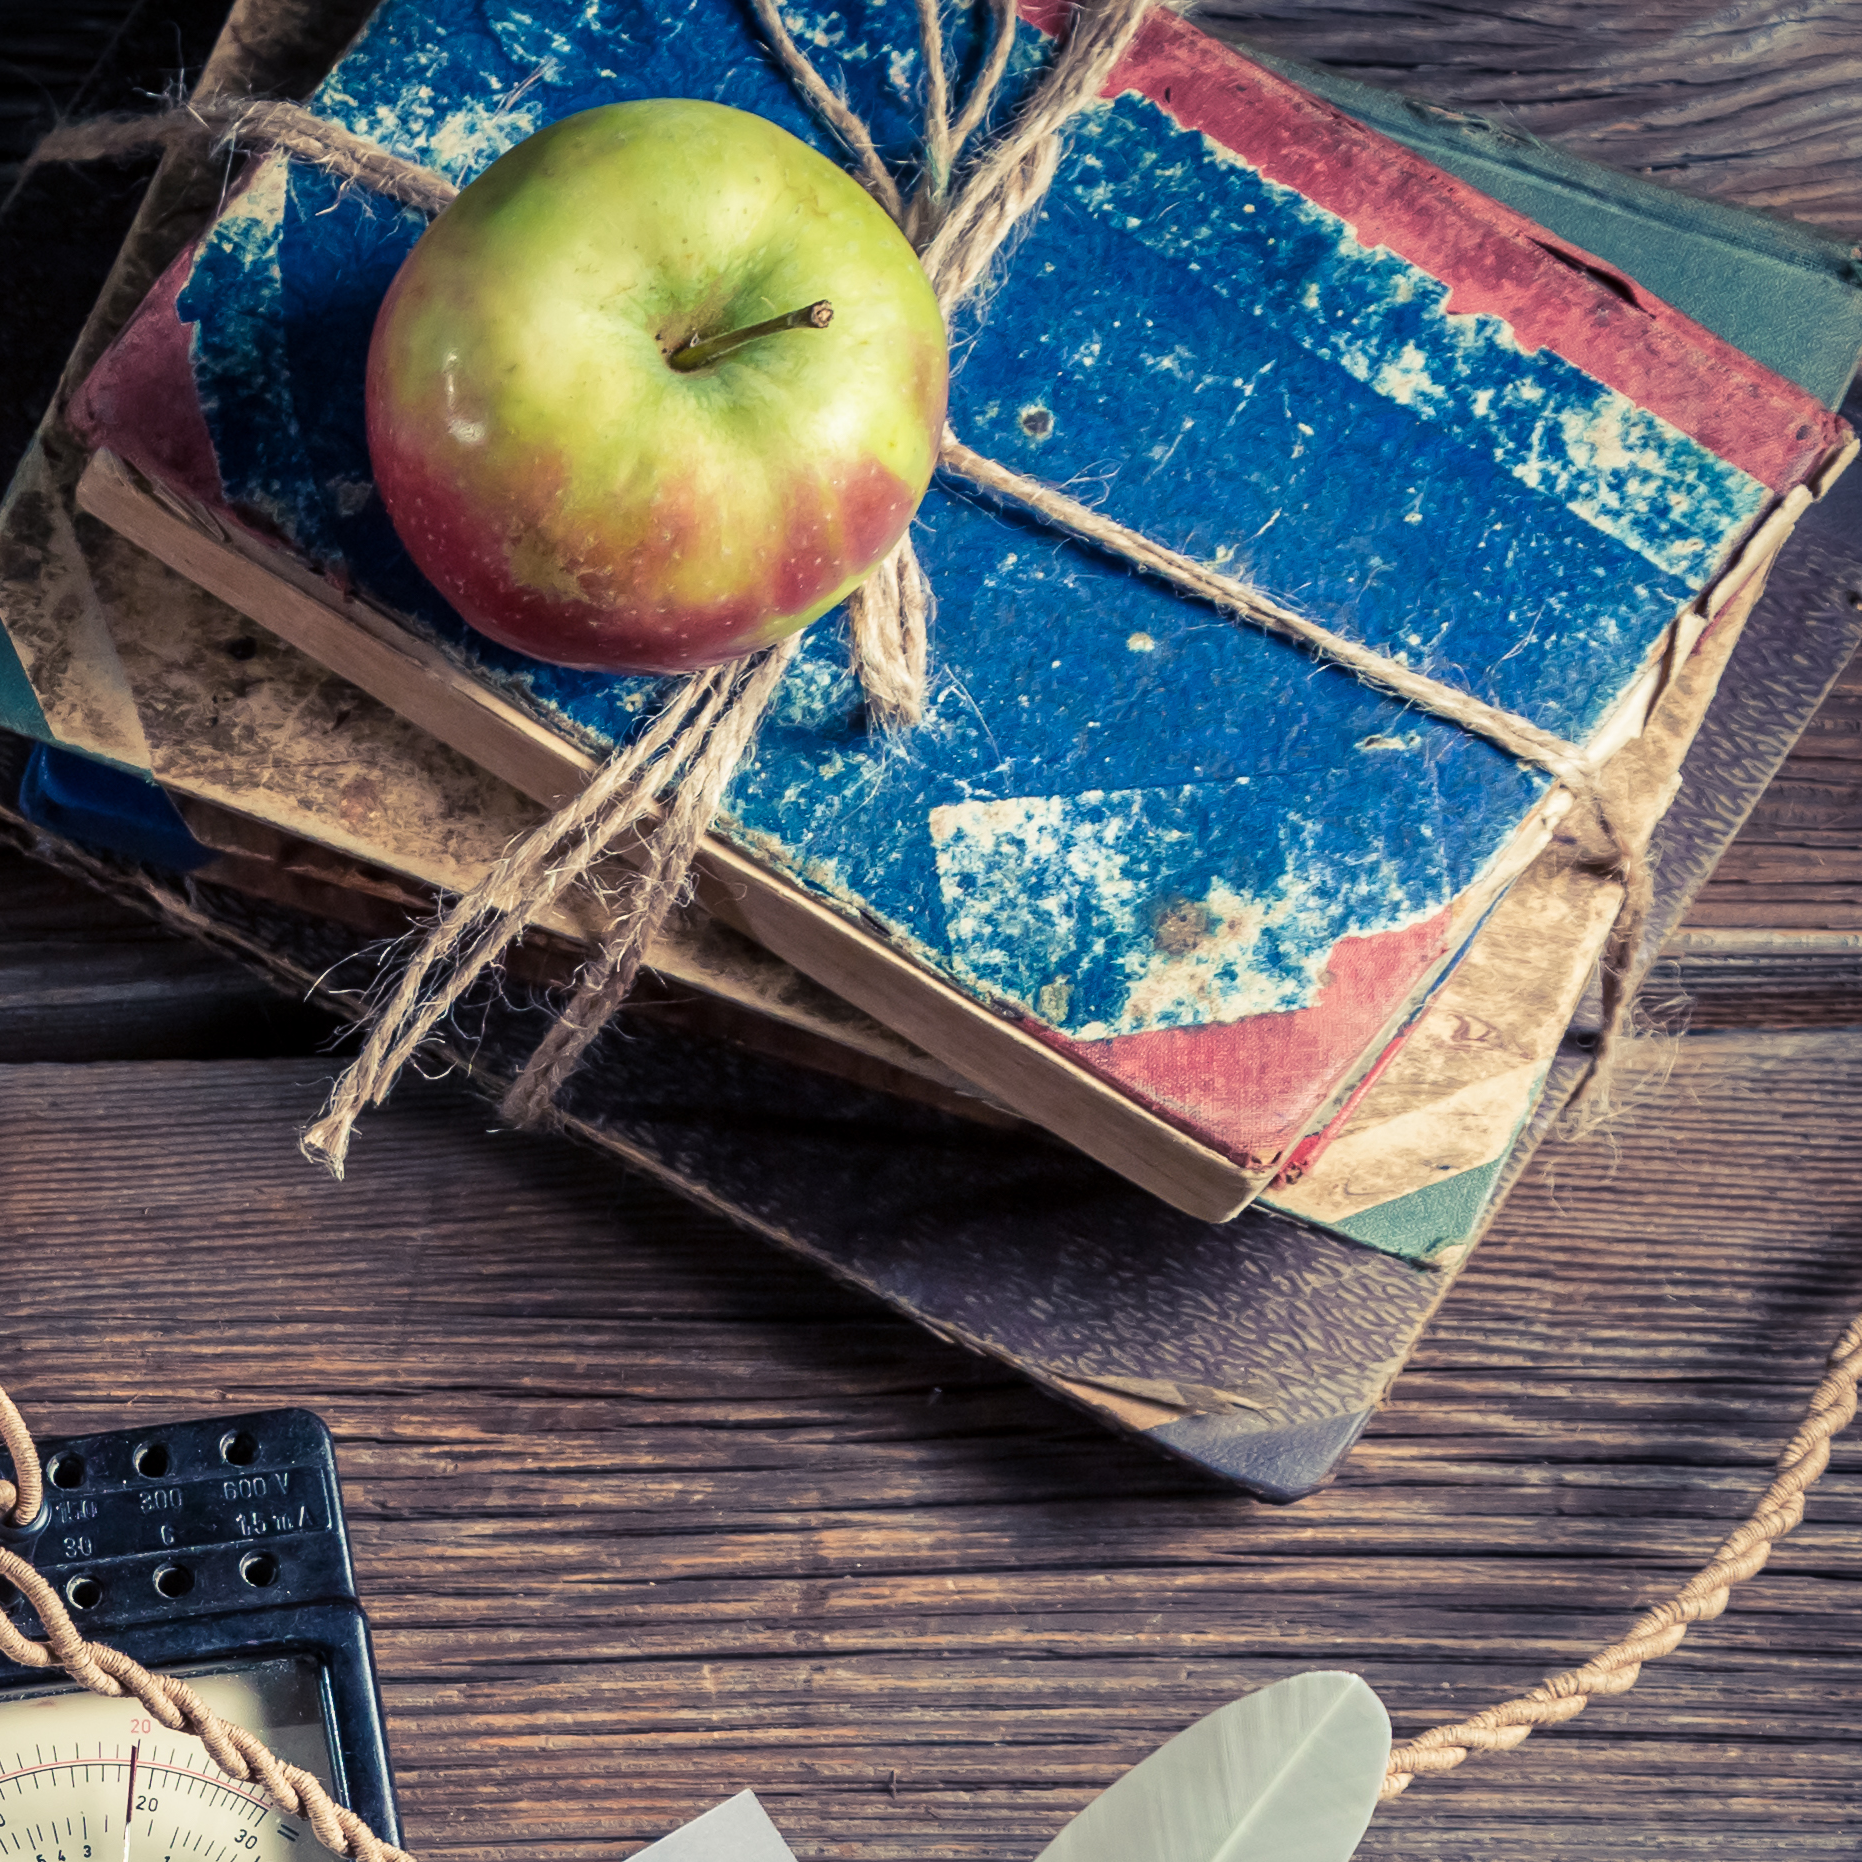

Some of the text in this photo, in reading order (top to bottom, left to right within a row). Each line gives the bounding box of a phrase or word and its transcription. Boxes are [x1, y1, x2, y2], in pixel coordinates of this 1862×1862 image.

[222, 1470, 292, 1502] 600 V
[63, 1534, 94, 1559] 30
[129, 1718, 153, 1736] 20
[136, 1795, 160, 1814] 20
[233, 1828, 259, 1851] 30
[82, 1844, 93, 1861] 3
